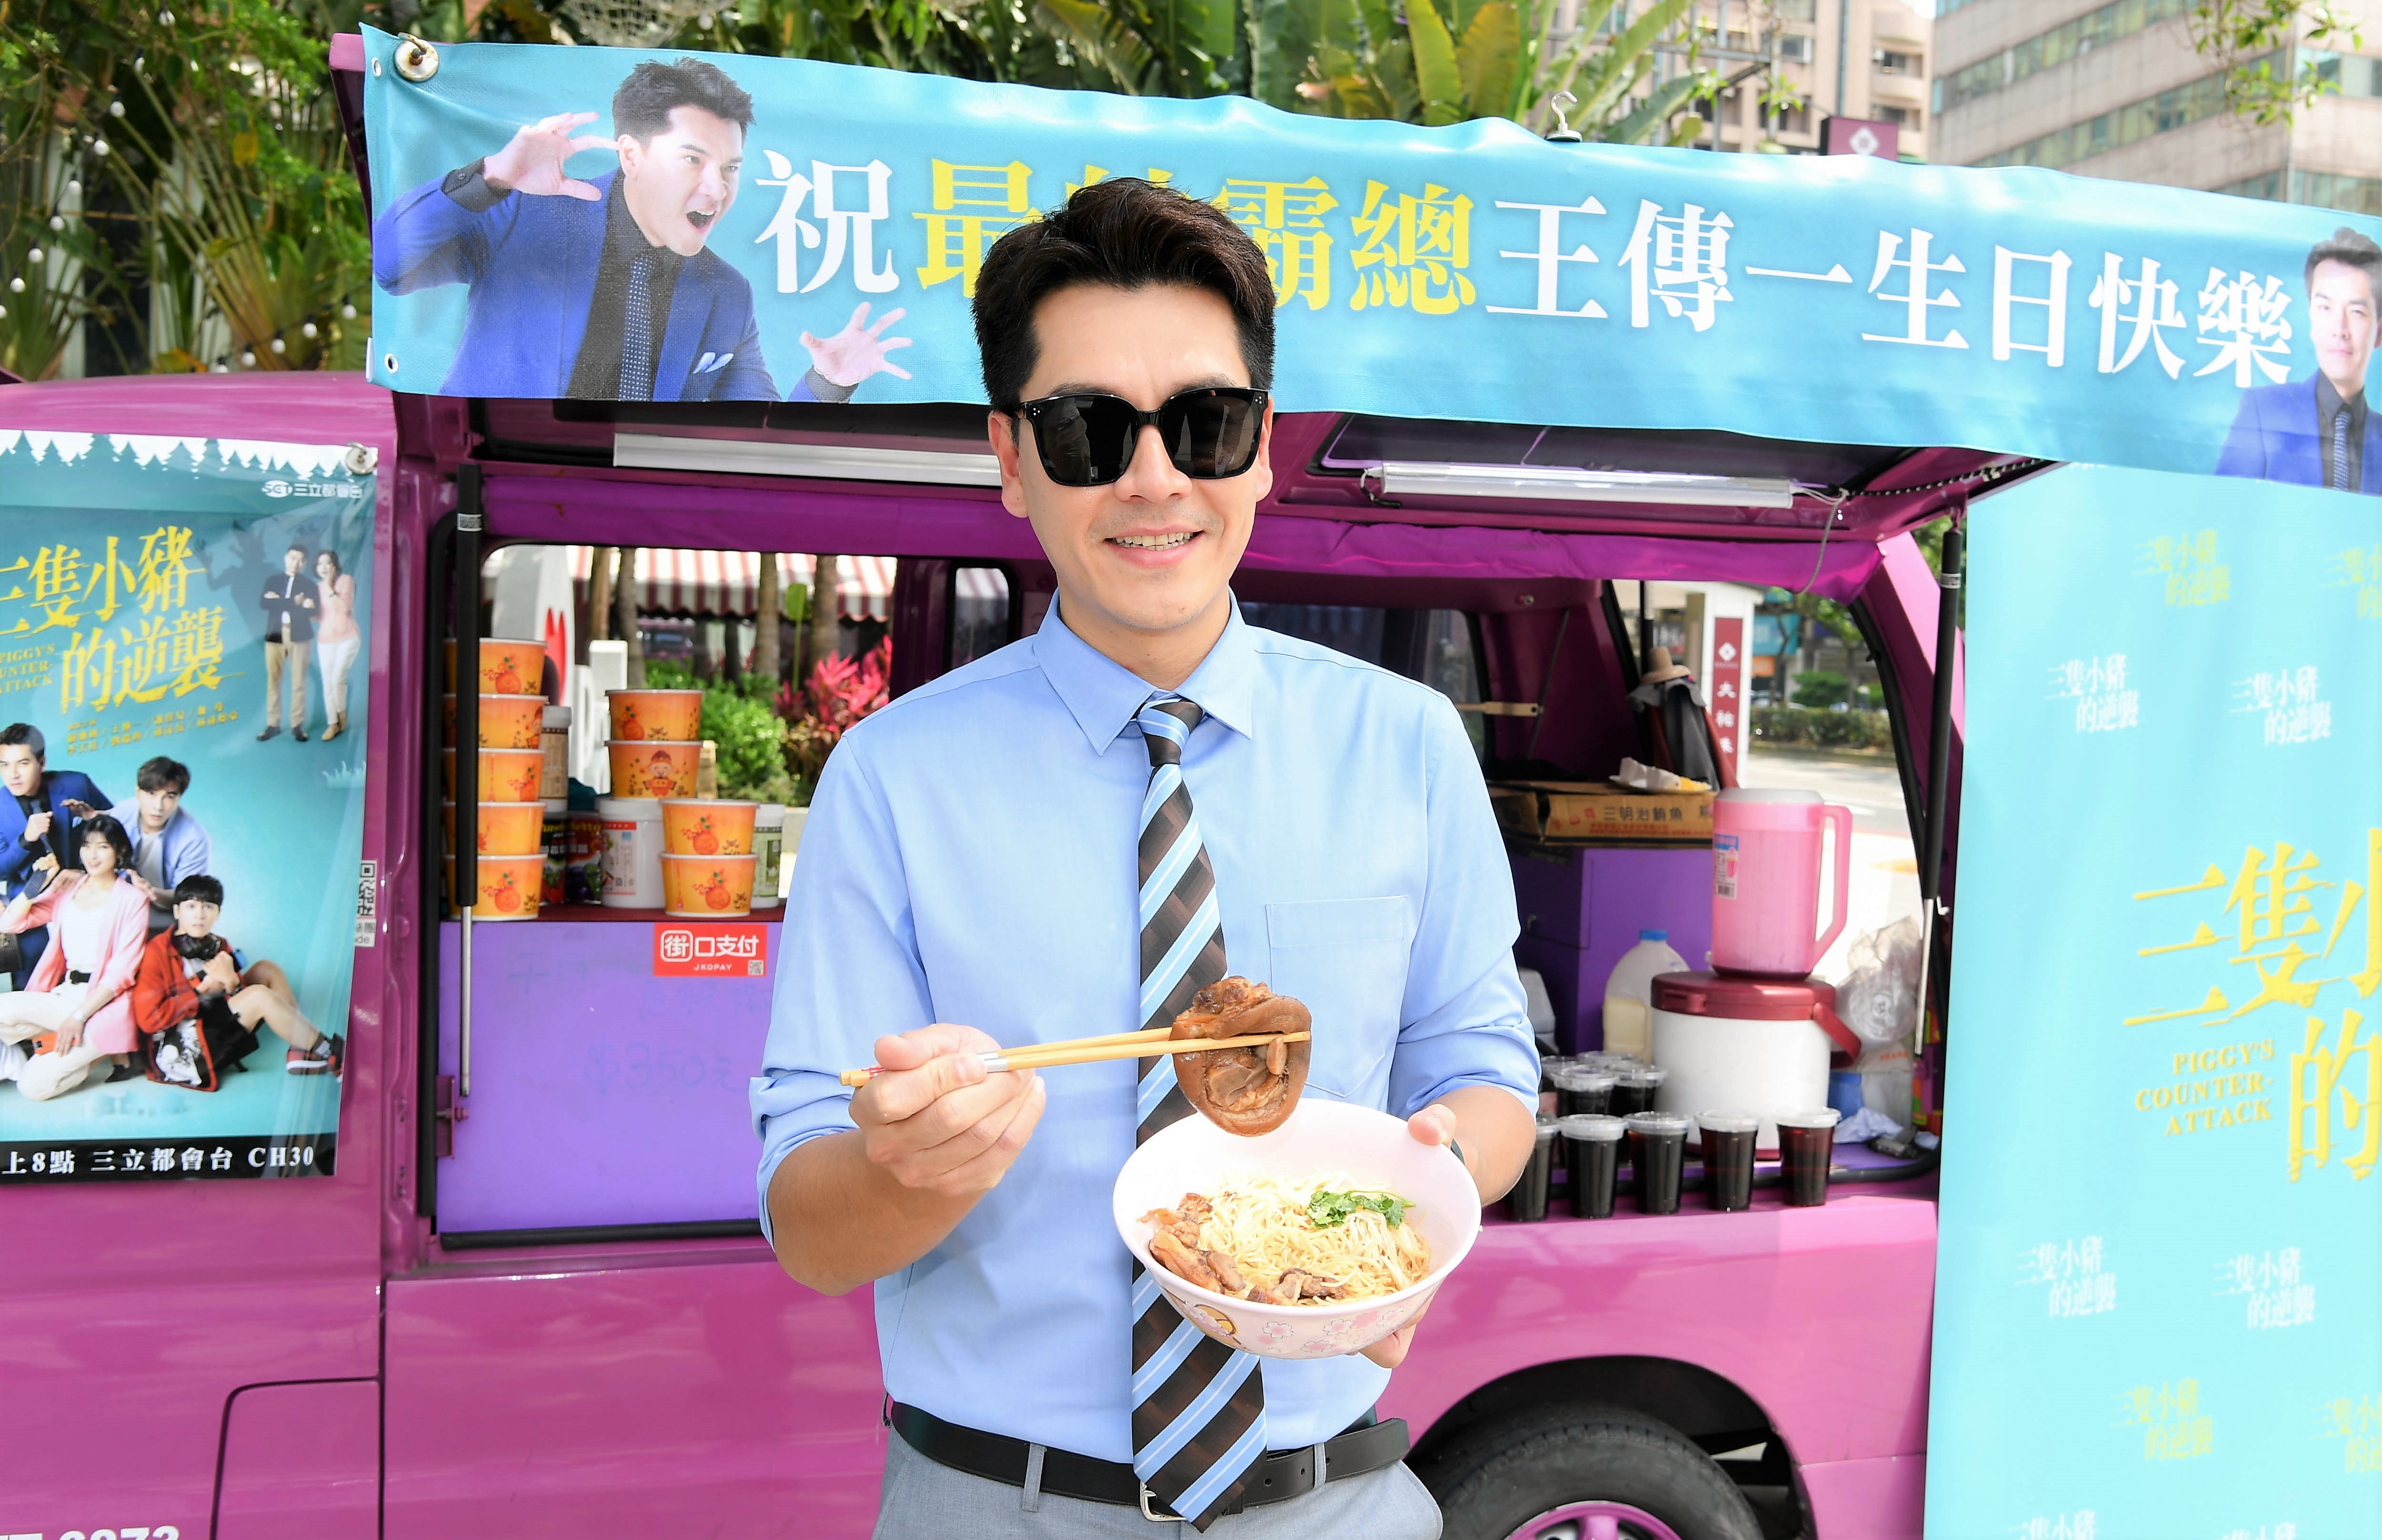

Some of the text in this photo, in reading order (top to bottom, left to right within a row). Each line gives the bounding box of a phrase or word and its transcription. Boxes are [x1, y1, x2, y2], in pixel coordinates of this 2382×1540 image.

[754, 149, 2292, 389] 祝最霸總王傳一生日快樂
[60, 605, 246, 715] 的逆襲
[2044, 653, 2131, 699] 三隻小豬
[2076, 689, 2140, 733] 的逆襲
[2230, 665, 2320, 713] 三隻小豬
[2264, 701, 2332, 746] 的逆襲
[663, 933, 759, 959] 街口支付
[2172, 1039, 2275, 1075] PIGGY'S
[2135, 1072, 2274, 1111] COUNTER-
[2164, 1098, 2272, 1137] ATTACK
[1, 1146, 315, 1175] 上8點 三立都會台 CH30
[2014, 1234, 2104, 1285] 三隻小豬
[2211, 1246, 2303, 1297] 三隻小豬
[2048, 1272, 2118, 1320] 的逆襲
[2247, 1283, 2316, 1330] 的逆襲
[2310, 1392, 2382, 1440] 三隻小
